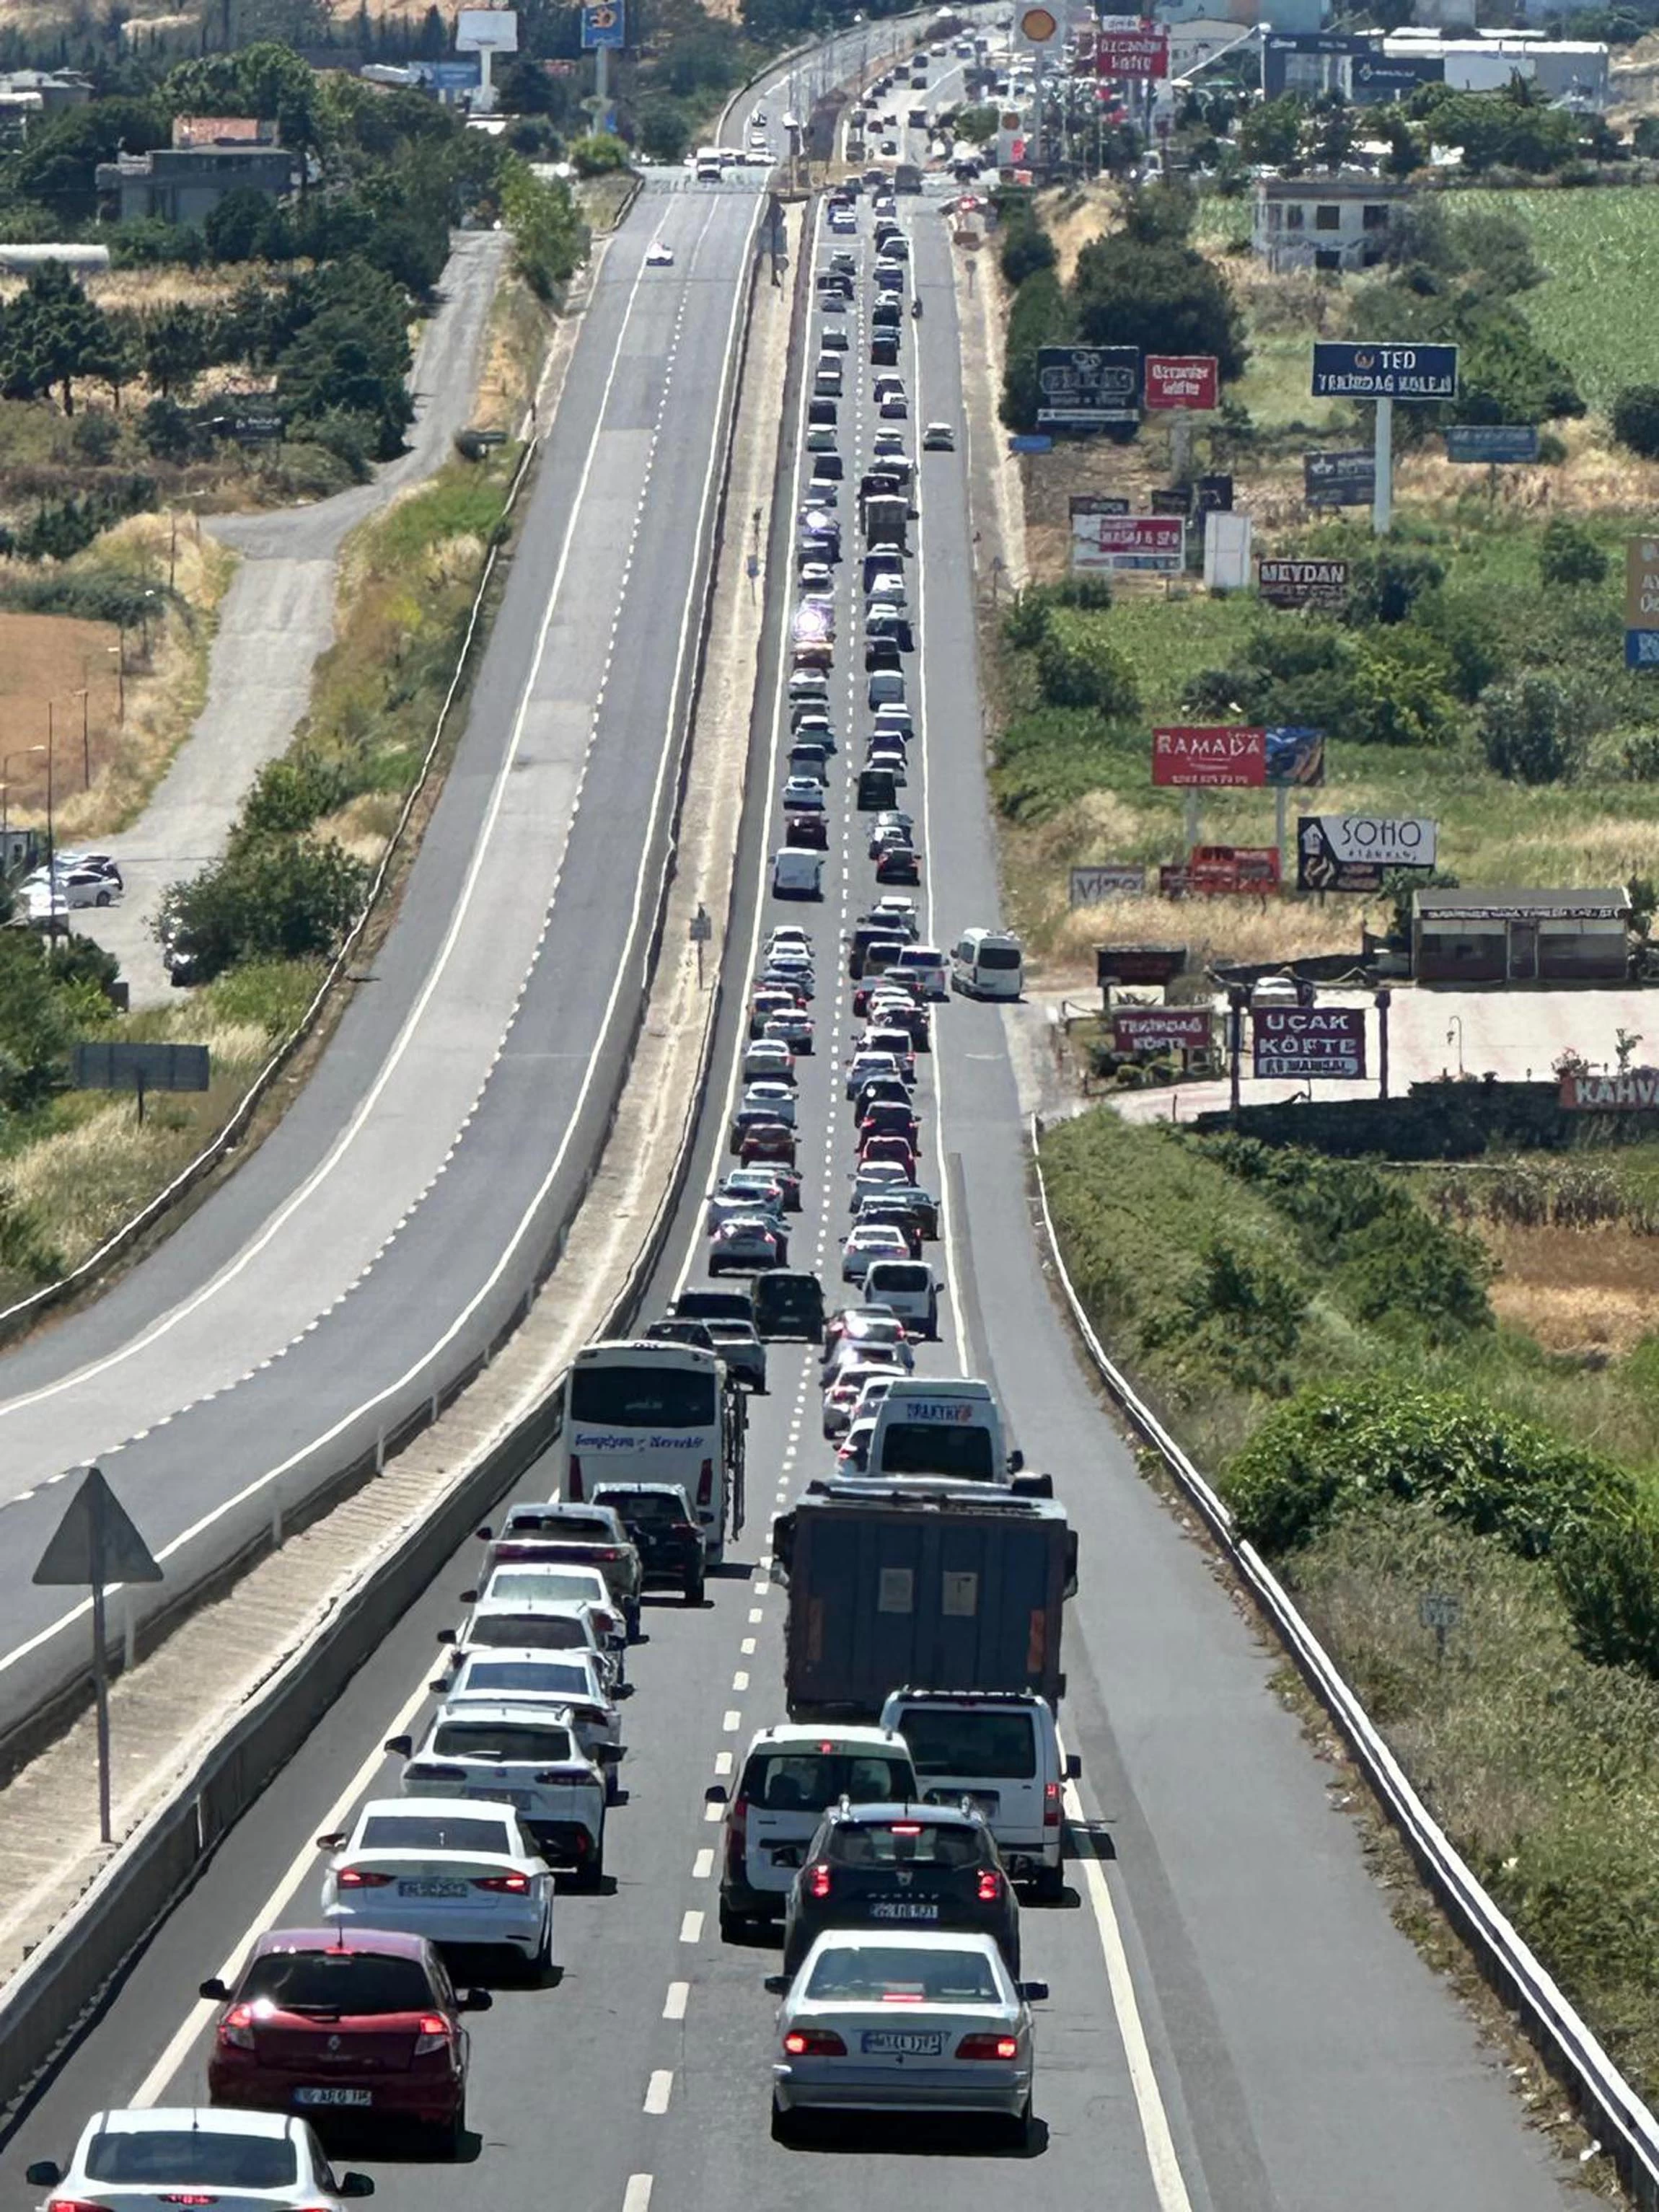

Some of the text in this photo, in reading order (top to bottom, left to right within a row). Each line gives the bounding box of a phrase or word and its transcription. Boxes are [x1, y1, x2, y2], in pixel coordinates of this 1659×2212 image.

[1381, 351, 1416, 369] TED
[1261, 564, 1345, 583] MEYDAN
[1157, 733, 1261, 757] RAMADA
[1342, 819, 1422, 847] SOHO
[1266, 1013, 1350, 1034] UÇAK
[1259, 1034, 1357, 1054] KÖFTE
